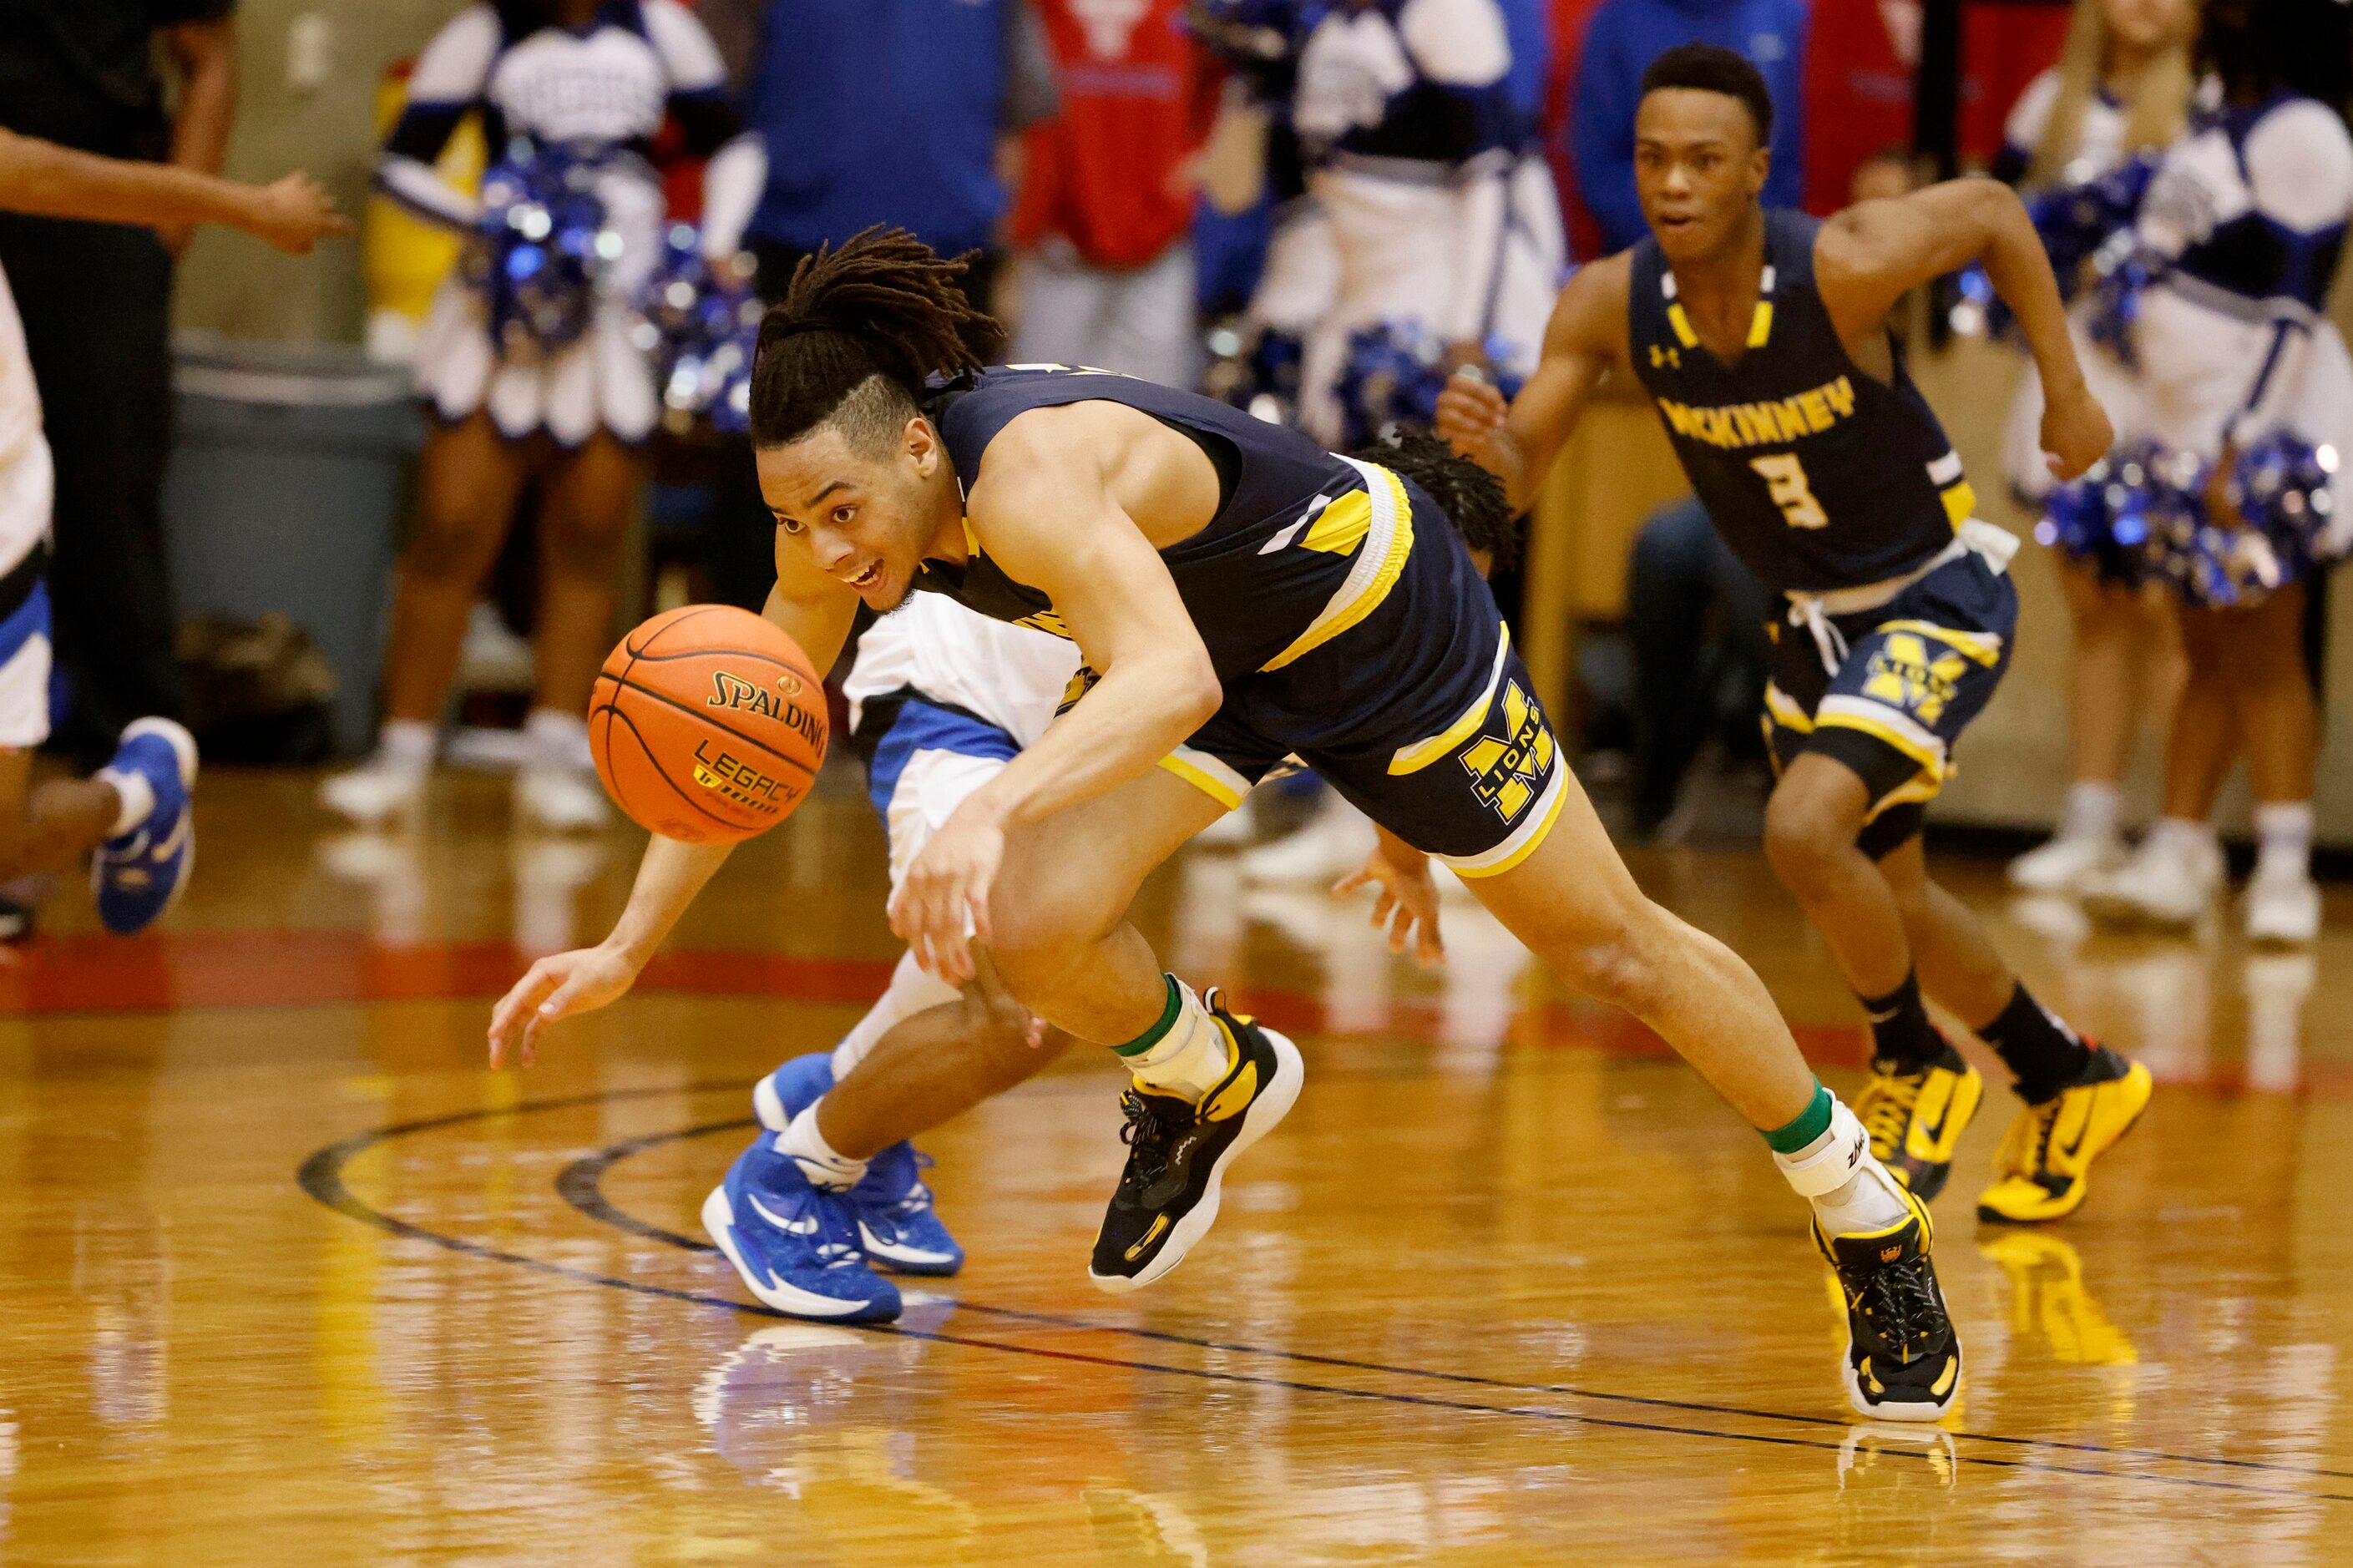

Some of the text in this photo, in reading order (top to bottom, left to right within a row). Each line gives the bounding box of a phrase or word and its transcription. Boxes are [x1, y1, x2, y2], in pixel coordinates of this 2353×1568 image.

[1749, 452, 1830, 529] 3
[707, 670, 827, 760] SPALDING
[1478, 706, 1540, 798] LIONS
[694, 738, 802, 802] LEGACY
